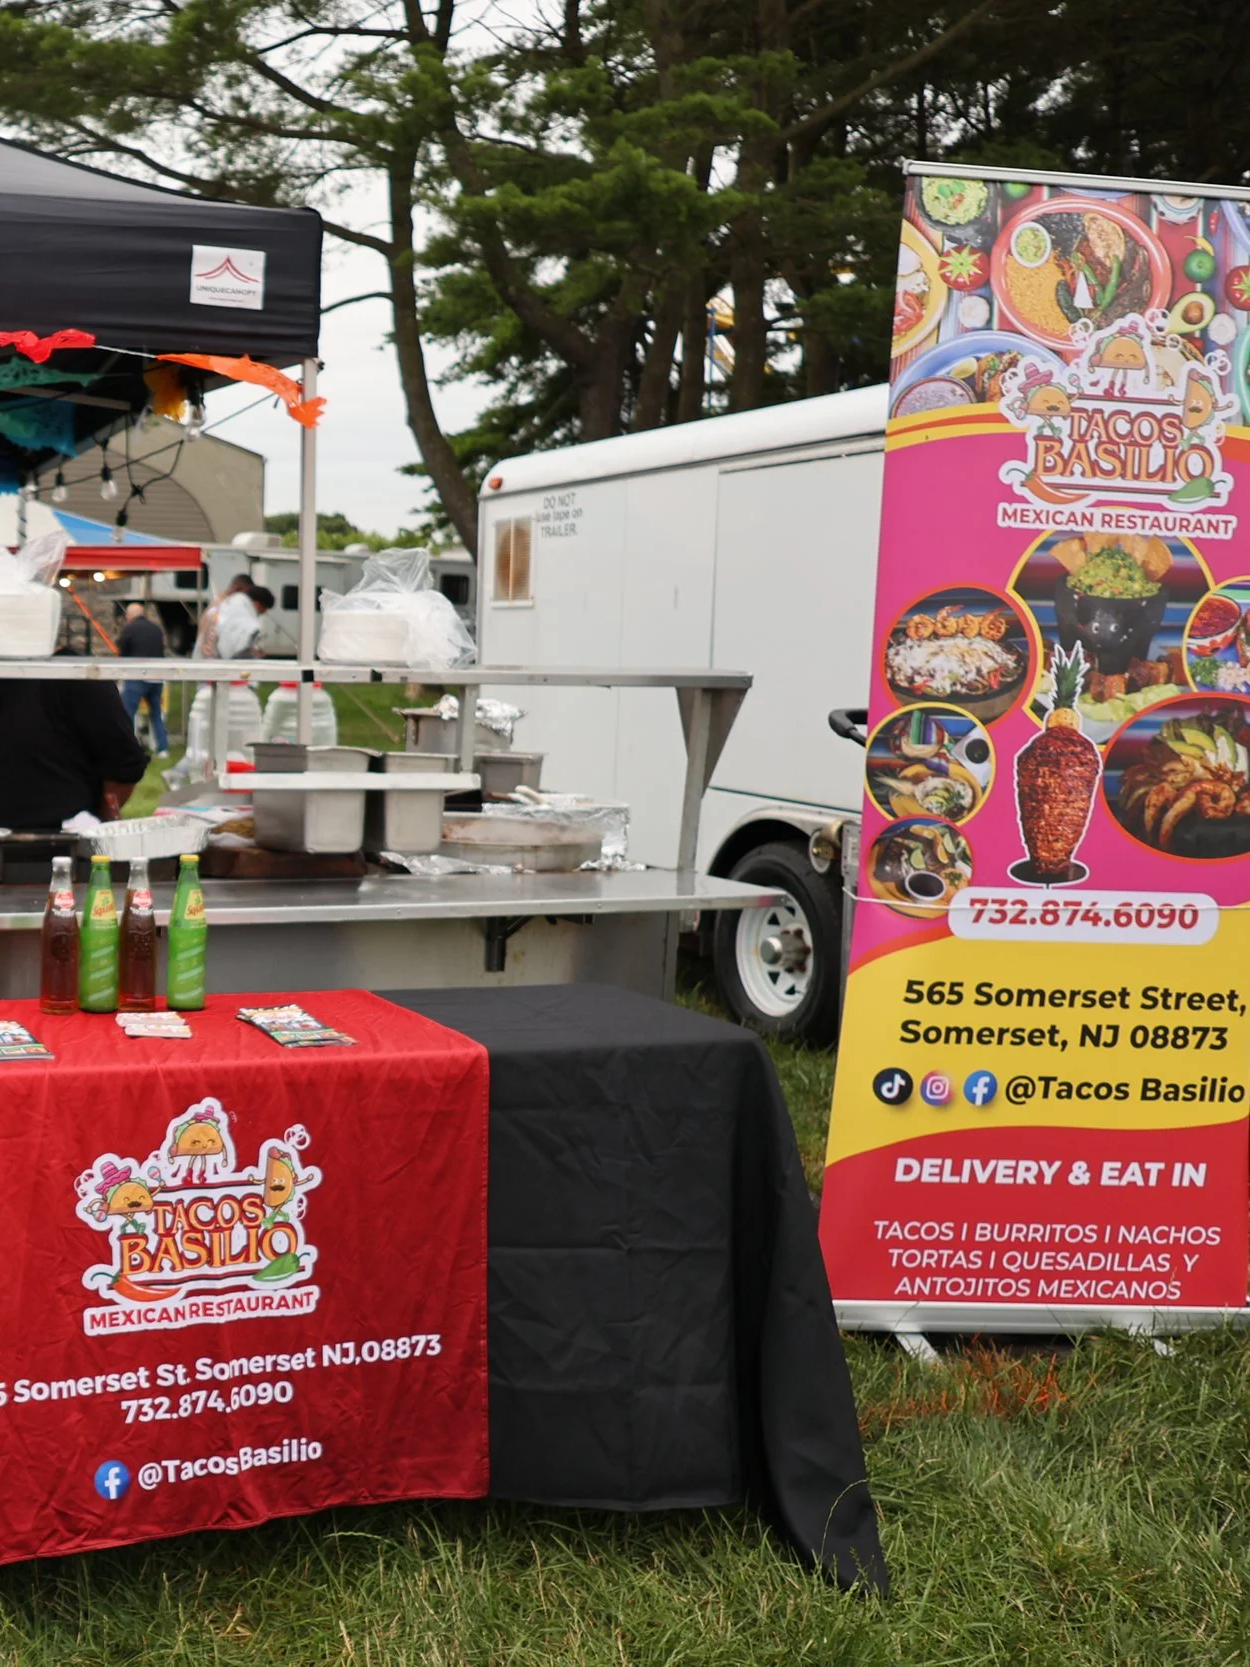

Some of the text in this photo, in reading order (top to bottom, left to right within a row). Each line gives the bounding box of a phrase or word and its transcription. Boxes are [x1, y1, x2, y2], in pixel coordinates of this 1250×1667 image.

[1070, 407, 1184, 448] TACOS
[1034, 434, 1215, 485] BASILIO
[543, 492, 576, 510] DO NOT
[1001, 506, 1233, 536] MEXICAN RESTAURANT
[93, 903, 116, 917] Squi
[187, 903, 206, 917] Squ
[969, 896, 1200, 931] 732.874.6090
[903, 978, 1248, 1017] 565 Somerset Street,
[898, 1019, 1229, 1053] Somerset, NJ 08873
[1005, 1075, 1246, 1106] @Tacos Basilio
[894, 1157, 1207, 1188] DELIVERY & EAT IN
[150, 1192, 266, 1236] TACOS
[118, 1221, 299, 1277] BASILIO
[874, 1219, 955, 1242] TACOS
[974, 1223, 1098, 1244] BURRITOS
[1117, 1224, 1222, 1246] NACHOS
[888, 1248, 983, 1270] TORTAS
[1001, 1250, 1171, 1274] QUESADILLAS
[1183, 1253, 1200, 1273] Y
[894, 1276, 1182, 1300] ANTOJITOS MEXICANOS
[89, 1290, 314, 1330] MEXICAN RESTAURANT
[13, 1365, 150, 1405] Somerset
[155, 1362, 191, 1391] St.
[195, 1345, 317, 1382] Somerset
[120, 1380, 294, 1425] 732.874.6090
[137, 1437, 323, 1491] @TacosBasilio
